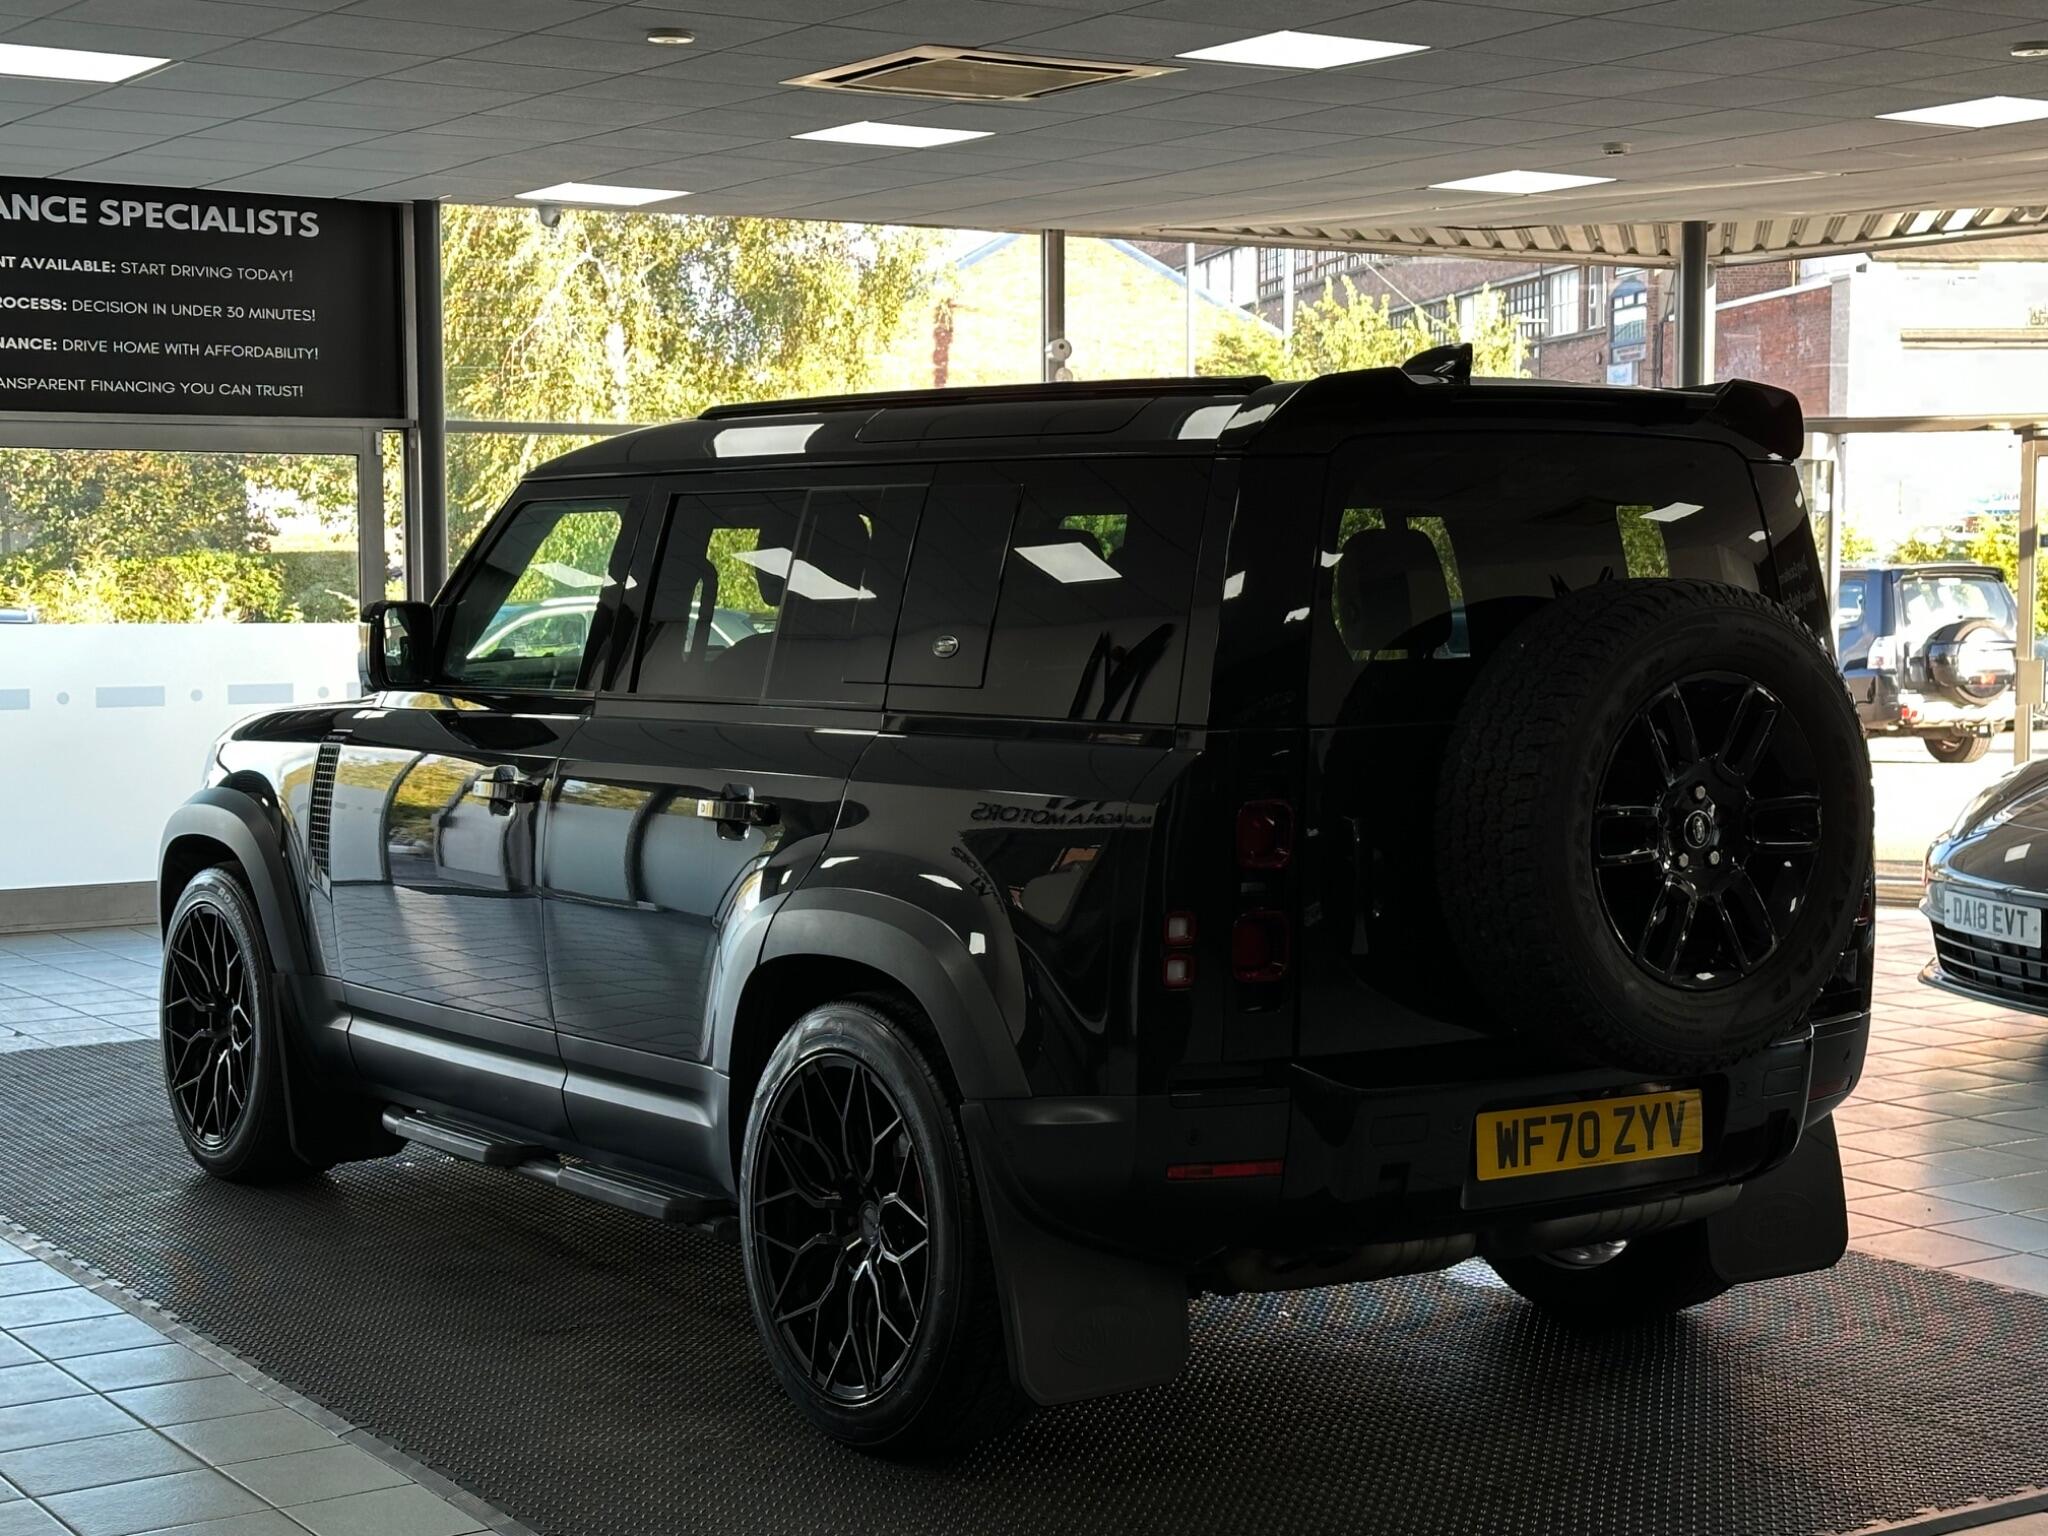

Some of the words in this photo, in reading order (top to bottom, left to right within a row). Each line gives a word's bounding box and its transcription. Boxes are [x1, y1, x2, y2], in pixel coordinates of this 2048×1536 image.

[99, 200, 319, 237] SPECIALISTS
[20, 257, 115, 273] AVAILABLE:
[121, 262, 166, 275] START
[171, 265, 232, 278] DRIVING
[237, 268, 292, 282] TODAY!
[0, 297, 67, 311] OCESS:
[72, 300, 147, 314] DECISION
[153, 304, 166, 314] IN
[172, 304, 222, 317] UNDER
[227, 307, 244, 318] 30
[249, 308, 315, 321] MINUTES!
[63, 339, 107, 352] DRIVE
[114, 341, 159, 354] HOME
[165, 343, 199, 355] WITH
[204, 345, 318, 360] AFFORDABILITY!
[91, 380, 175, 393] FINANCING
[180, 383, 214, 394] YOU
[219, 384, 251, 395] CAN
[256, 385, 303, 397] TRUST!
[1953, 897, 1988, 930] DA18
[1992, 904, 2028, 938] EVT
[1496, 1110, 1601, 1170] WF70
[1613, 1100, 1686, 1155] ZYV
